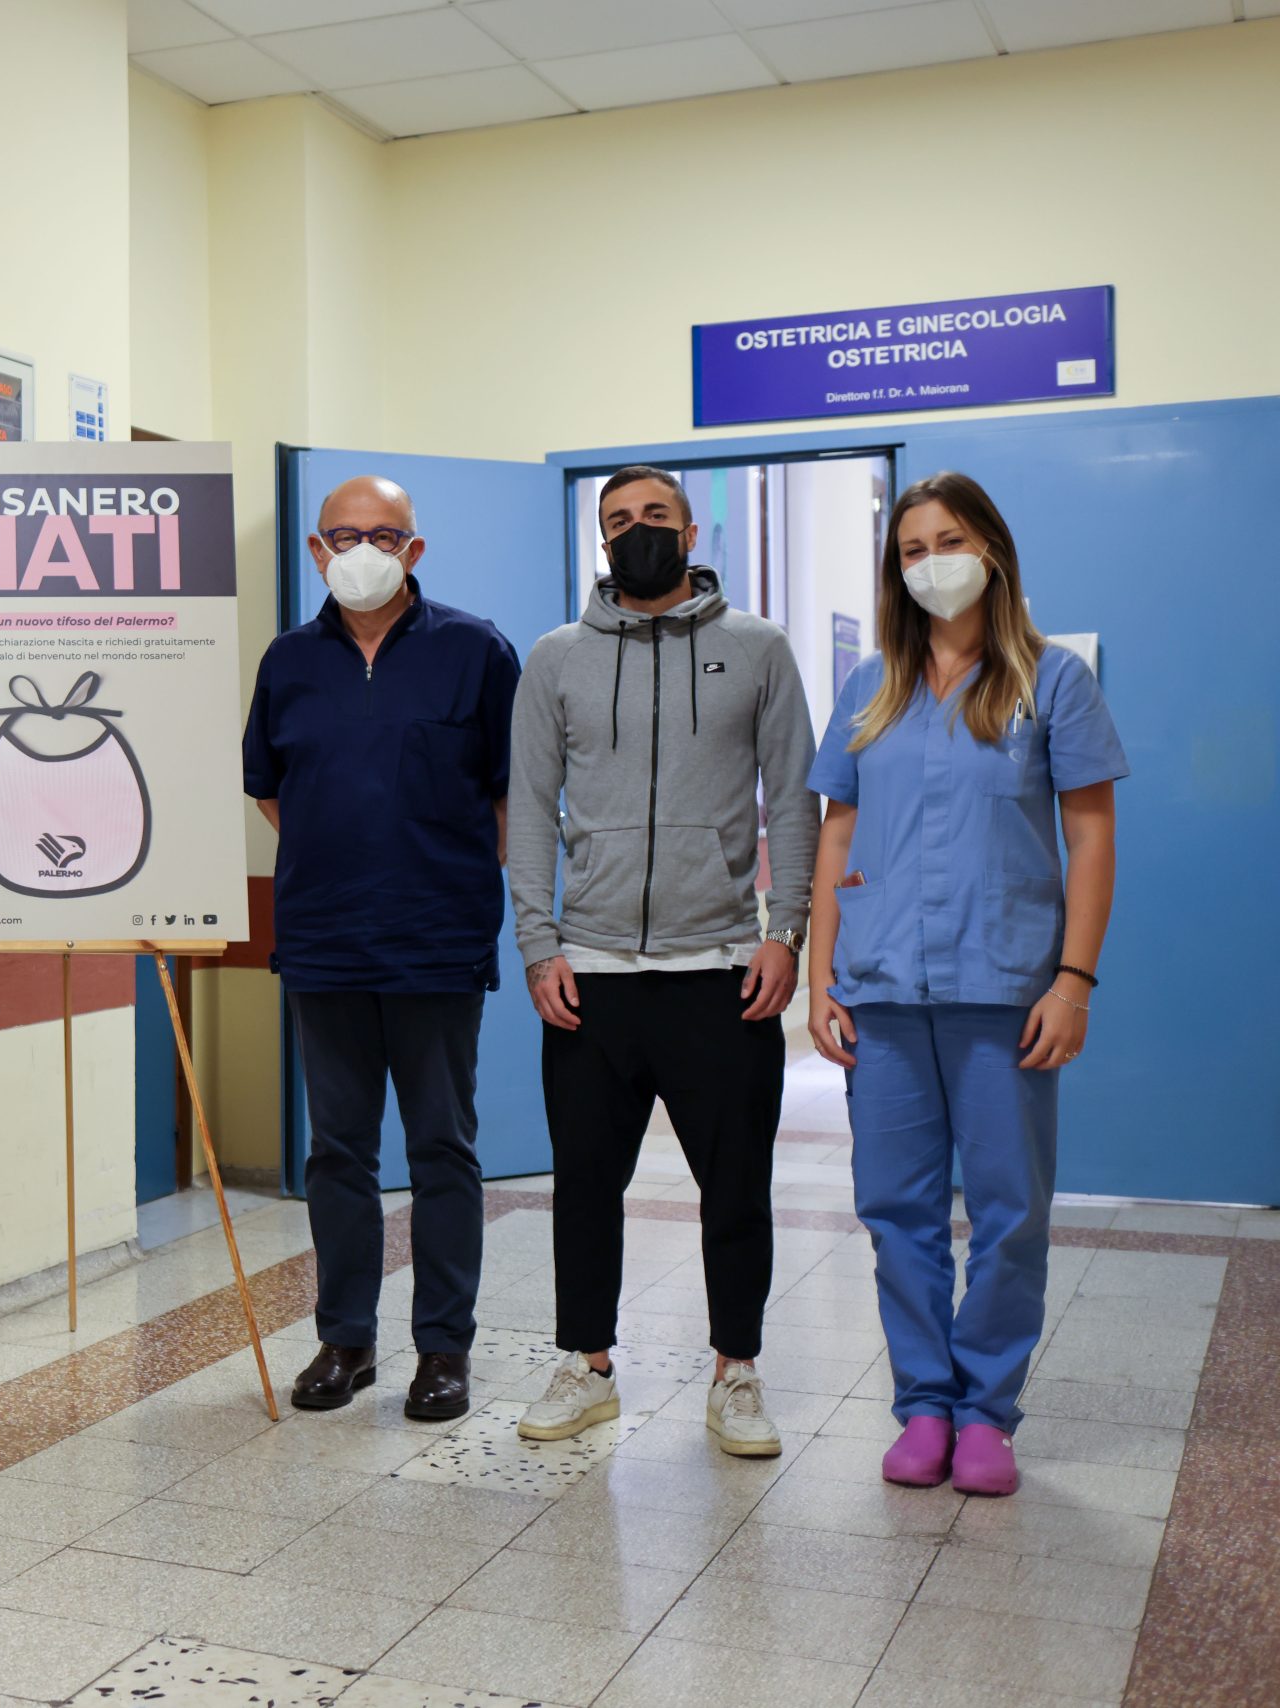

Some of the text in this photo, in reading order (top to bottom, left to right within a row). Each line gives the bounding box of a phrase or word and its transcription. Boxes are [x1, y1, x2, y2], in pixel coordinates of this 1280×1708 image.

[735, 303, 1066, 351] OSTETRICIA E GINECOLOGIA
[827, 339, 968, 369] OSTETRICIA
[826, 382, 969, 403] Direttore f.f. Dr. A. Maiorana
[15, 618, 54, 627] nuovo
[56, 615, 91, 627] tifoso
[94, 616, 113, 627] del
[116, 616, 175, 627] Palermo?
[58, 637, 94, 647] Nascita
[96, 638, 103, 647] e
[105, 637, 142, 647] richiedi
[144, 637, 216, 649] gratuitamente
[16, 652, 26, 661] di
[28, 652, 81, 661] benvenuto
[84, 651, 99, 660] nel
[102, 651, 138, 661] mondo
[140, 652, 186, 661] rosanero!
[38, 869, 83, 878] PALERMO
